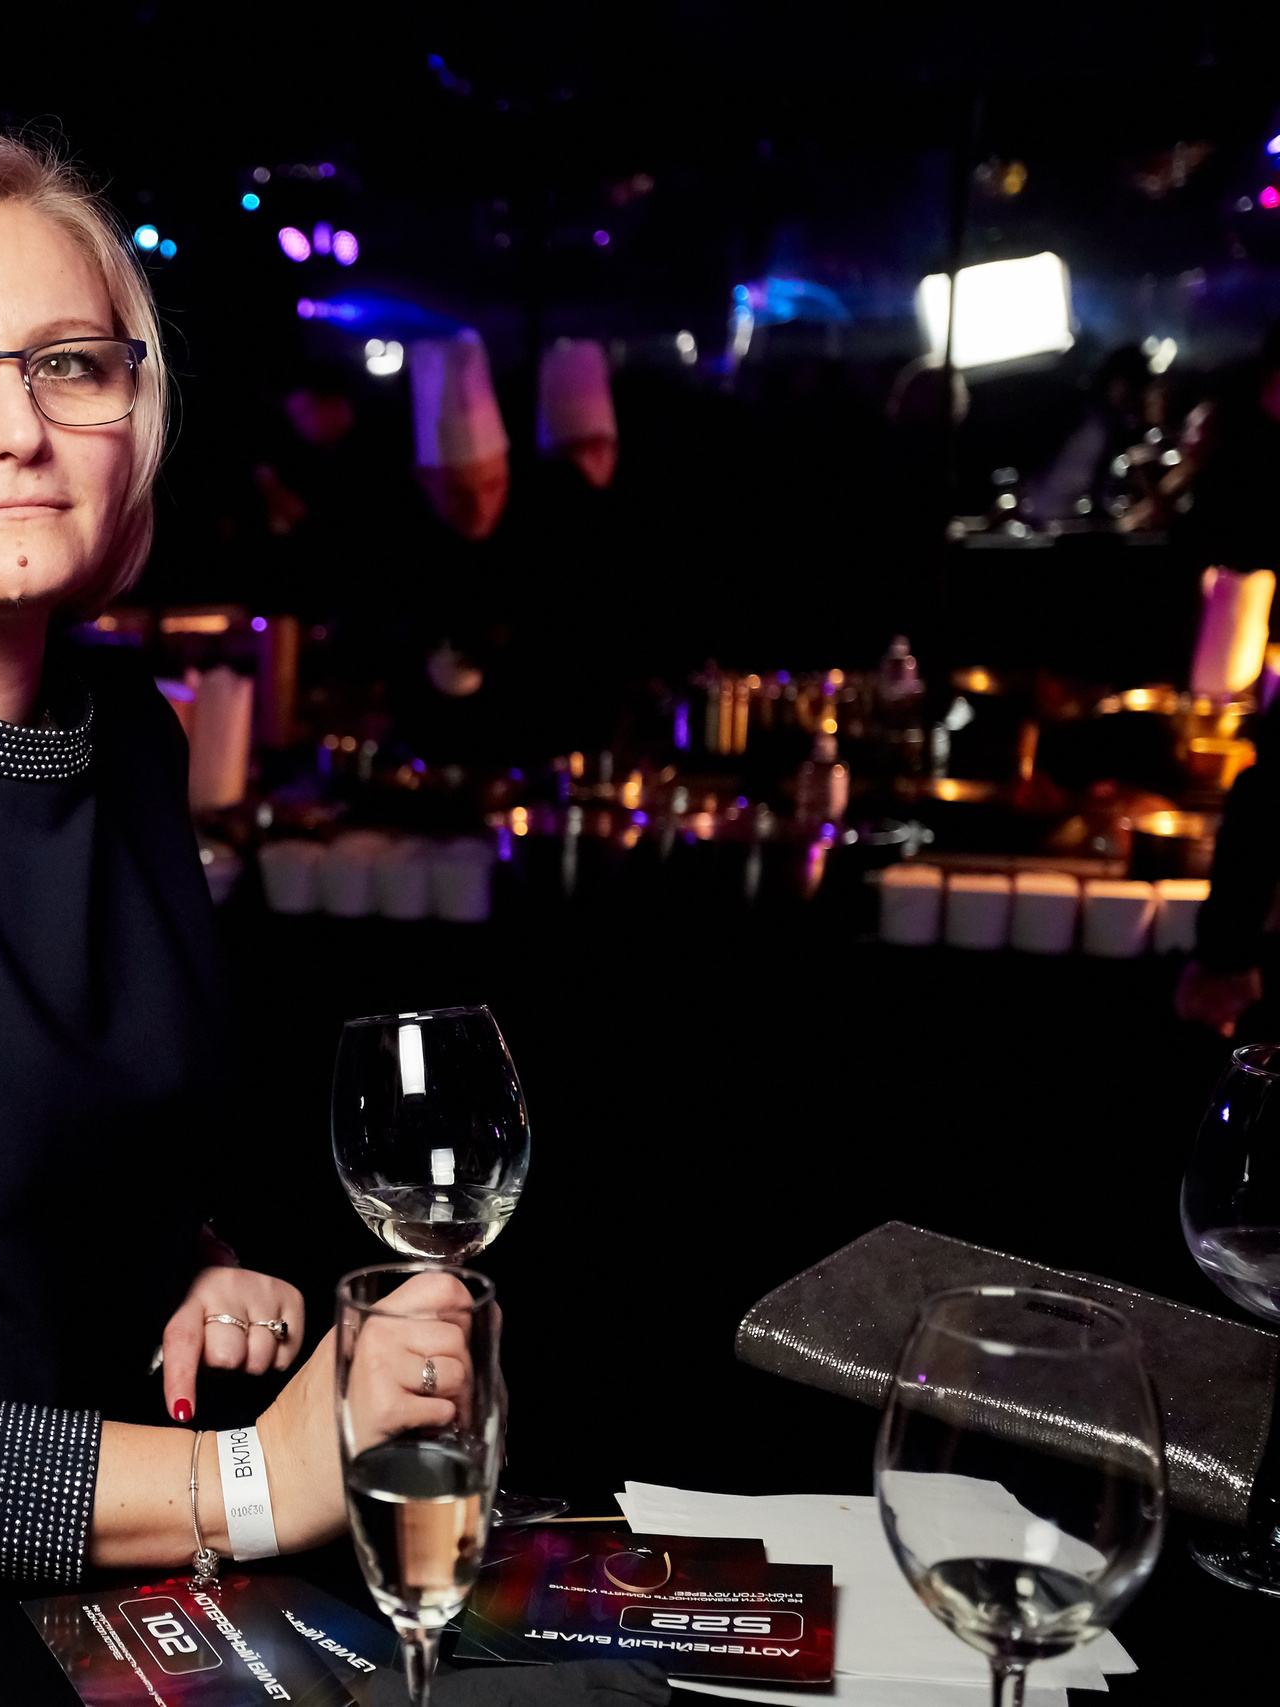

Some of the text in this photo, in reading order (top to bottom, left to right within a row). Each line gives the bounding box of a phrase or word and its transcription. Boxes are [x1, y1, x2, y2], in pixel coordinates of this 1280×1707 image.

[230, 1428, 253, 1478] ВКЛЮ
[549, 1584, 597, 1594] участие
[600, 1589, 651, 1598] принять
[141, 1612, 198, 1656] 102
[651, 1613, 771, 1634] 522
[194, 1592, 291, 1701] ЛОТЕРЕЙНЫЙ БИЛЕТ
[524, 1629, 800, 1657] ЛОТЕРЕЙНЫЙ БИЛЕТ
